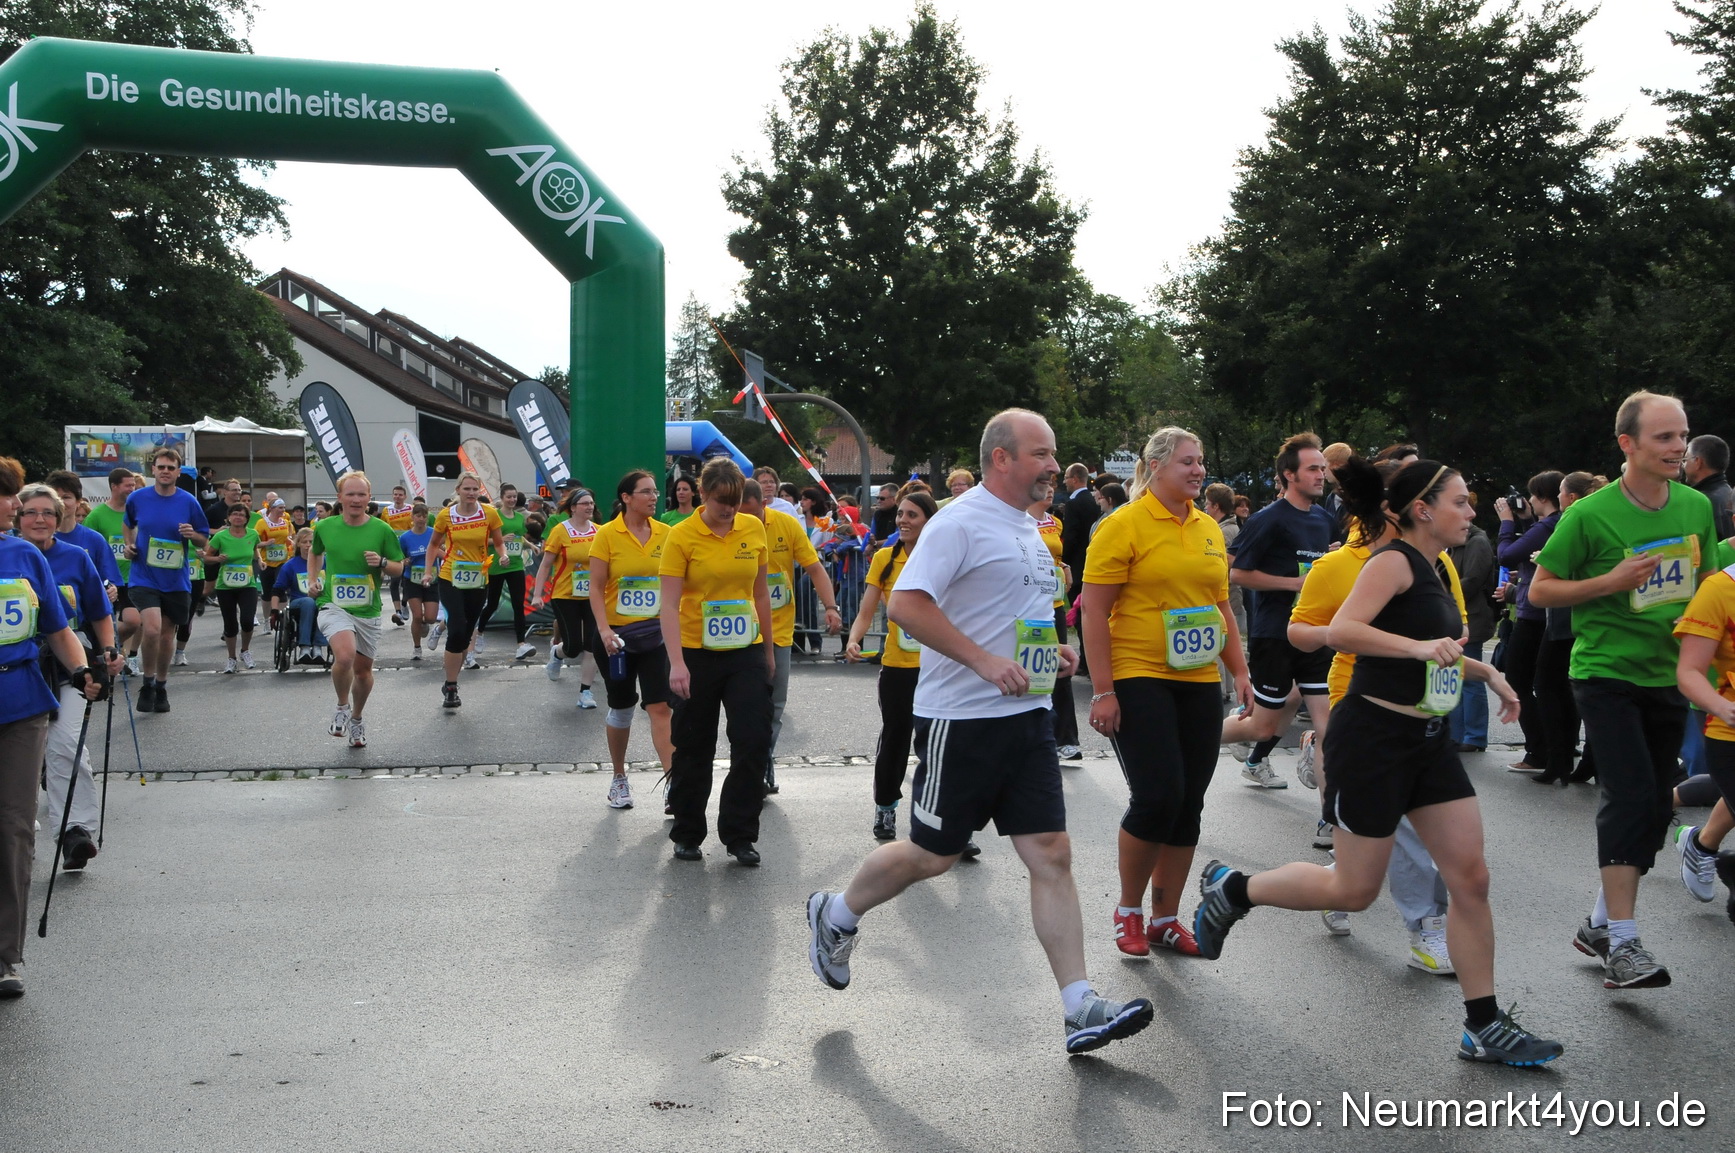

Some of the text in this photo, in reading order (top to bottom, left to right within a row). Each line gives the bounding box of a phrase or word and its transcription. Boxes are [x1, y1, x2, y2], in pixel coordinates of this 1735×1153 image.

[86, 72, 455, 124] Die Gesundheitskasse.
[485, 145, 627, 260] AOK
[75, 444, 118, 457] TLA
[453, 524, 468, 532] MAX
[156, 548, 175, 561] 87
[268, 549, 284, 558] 394
[226, 572, 246, 582] 749
[454, 571, 480, 583] 437
[336, 585, 366, 599] 862
[576, 580, 590, 592] 43
[621, 590, 656, 607] 689
[0, 600, 23, 626] 5
[708, 616, 747, 637] 690
[1173, 626, 1216, 655] 693
[1020, 646, 1058, 674] 1095
[1429, 667, 1459, 695] 1096
